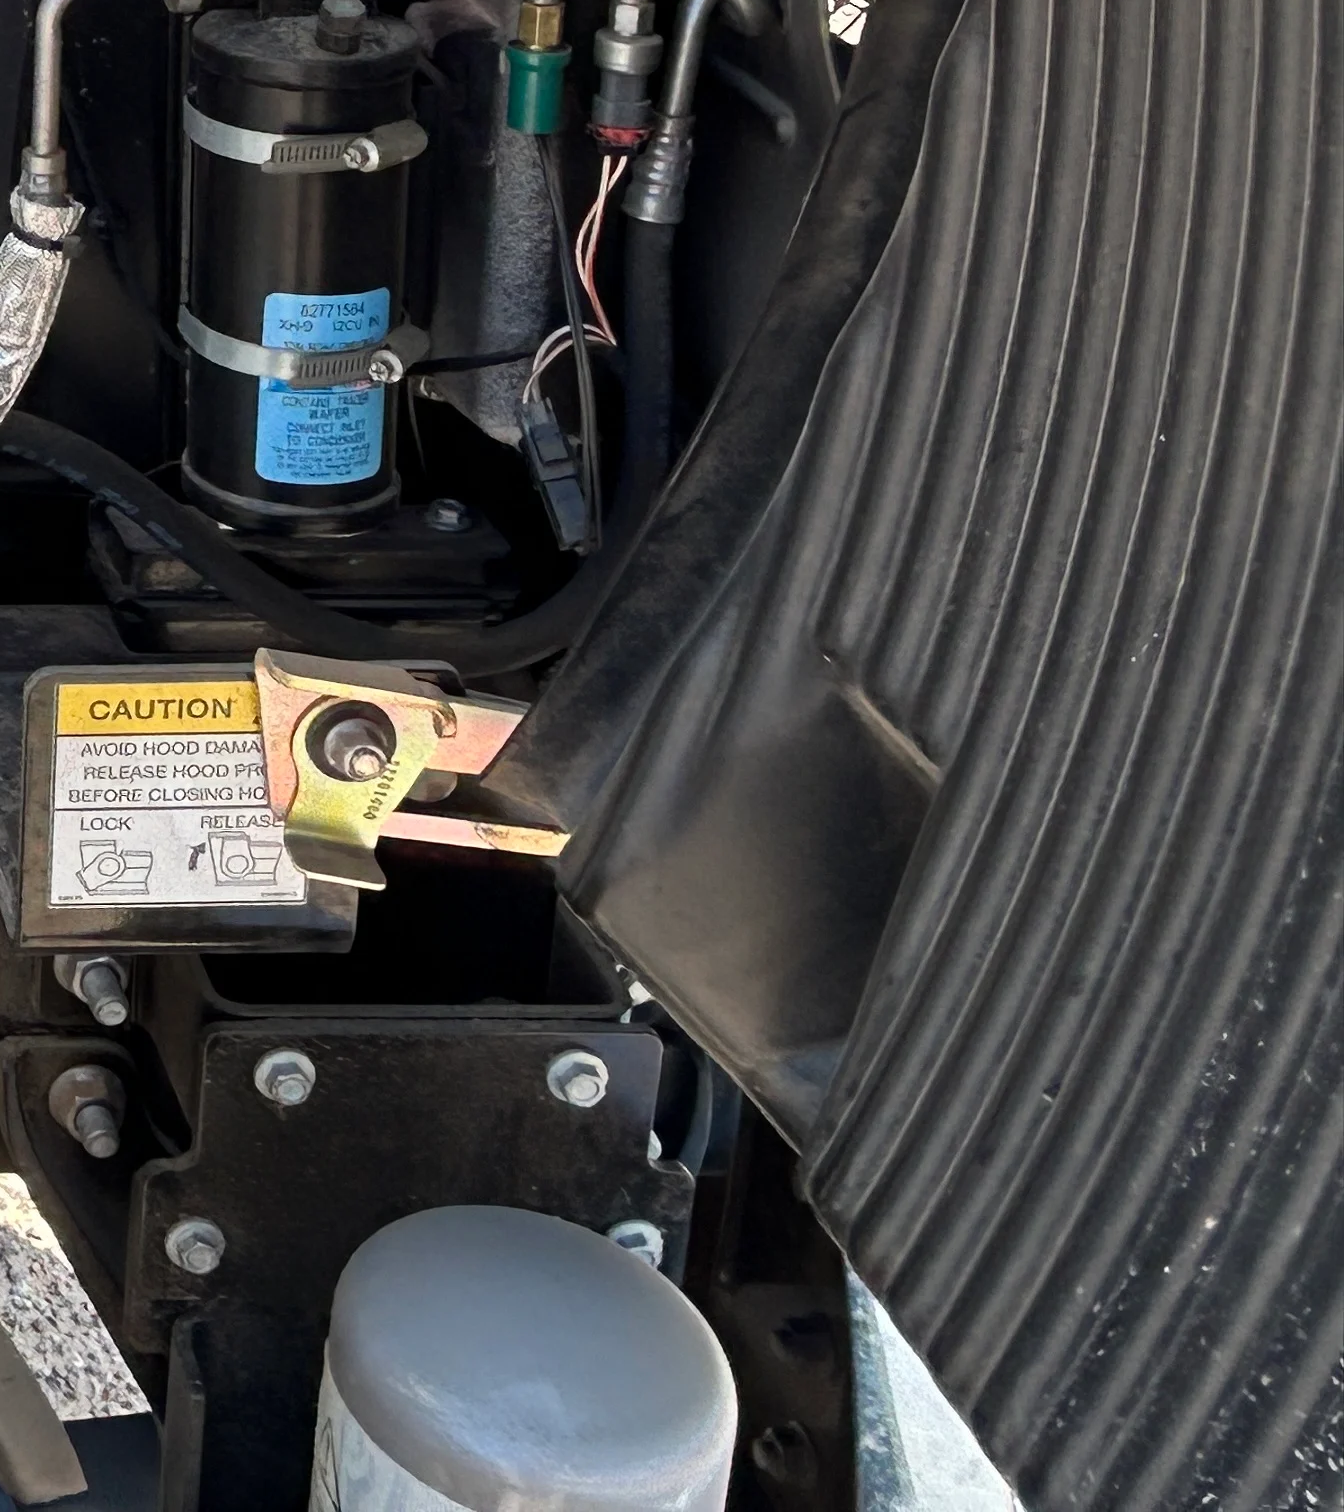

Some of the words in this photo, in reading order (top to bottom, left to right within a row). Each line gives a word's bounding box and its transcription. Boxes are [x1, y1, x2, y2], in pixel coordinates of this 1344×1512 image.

[88, 697, 234, 721] CAUTION
[80, 741, 137, 757] AVOID
[143, 740, 200, 756] HOOD
[205, 739, 262, 755] DAMA
[83, 764, 169, 781] RELEASE
[172, 763, 230, 779] HOOD
[68, 788, 142, 803] BEFORE
[147, 787, 234, 802] CLOSING
[238, 786, 266, 801] HO
[80, 815, 133, 832] LOCK
